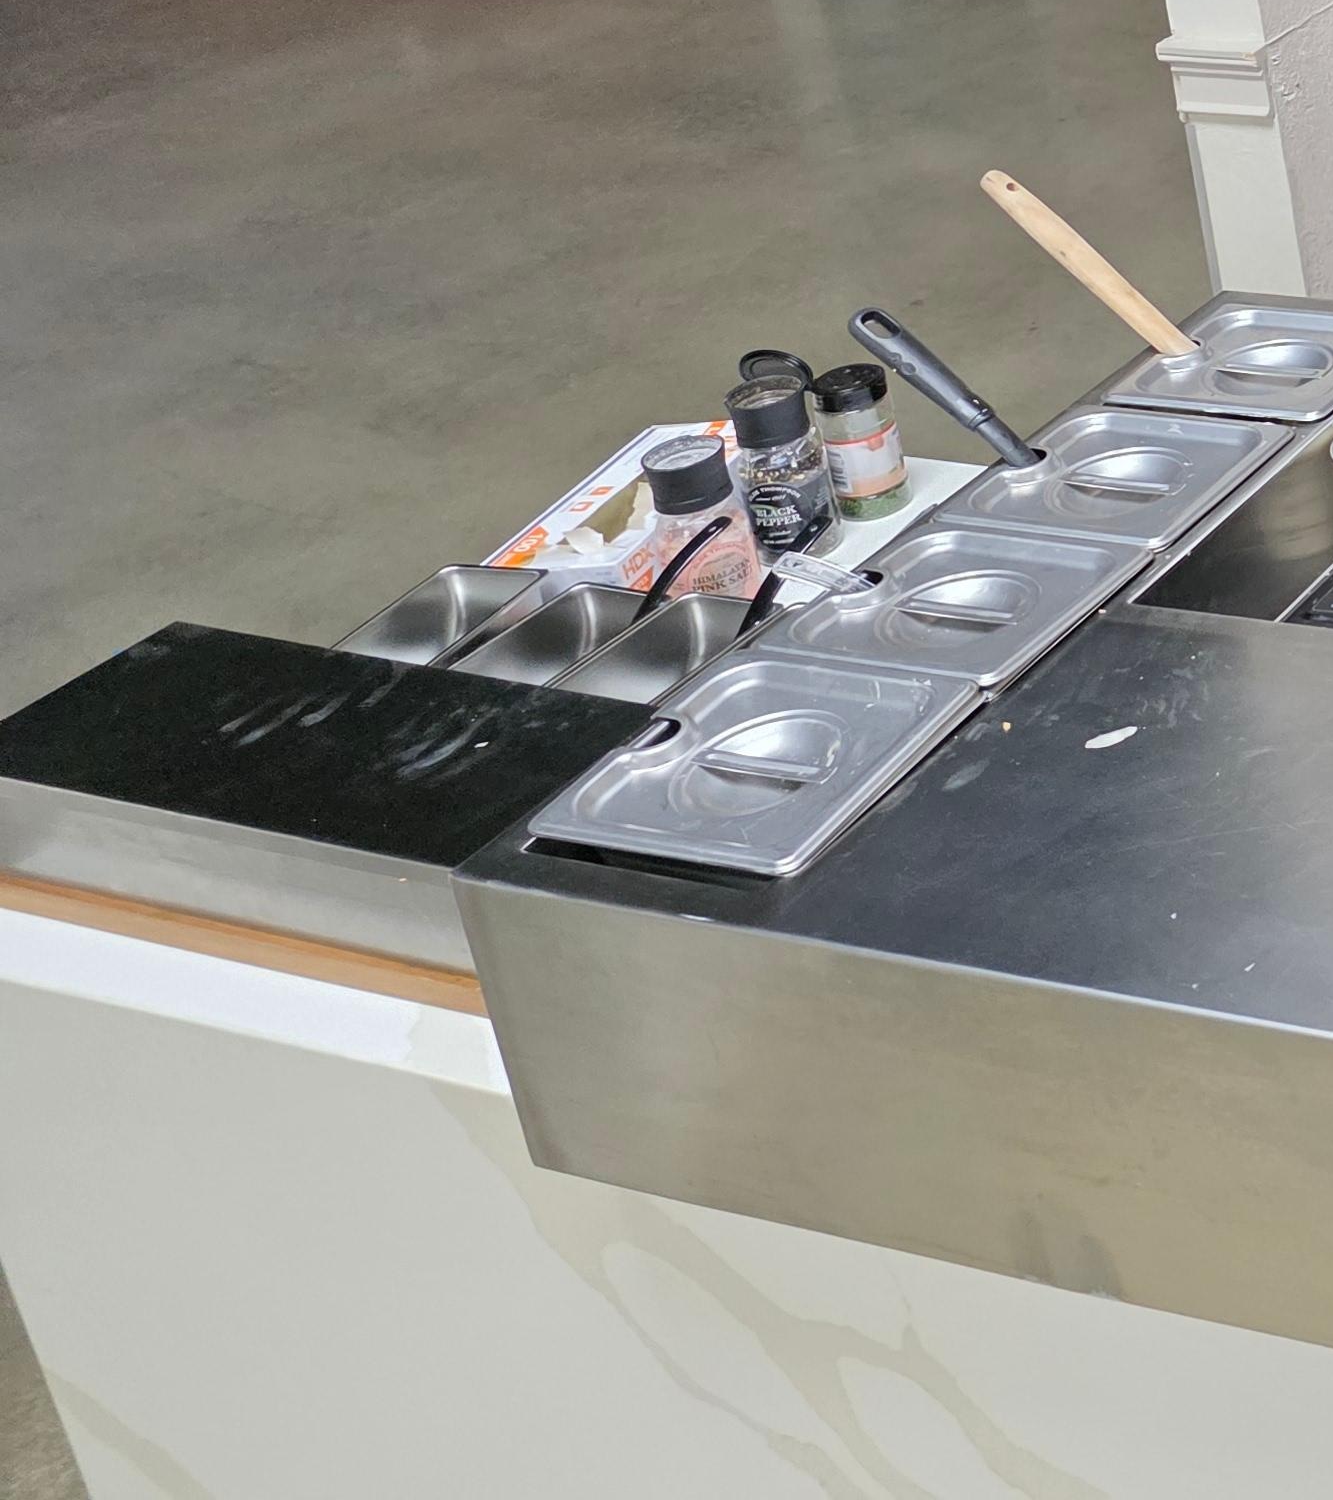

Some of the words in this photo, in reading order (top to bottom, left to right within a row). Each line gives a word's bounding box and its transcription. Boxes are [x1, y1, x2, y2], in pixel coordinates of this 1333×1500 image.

[755, 504, 798, 518] BLACK
[755, 513, 803, 527] PEPPER
[622, 541, 656, 581] HDX
